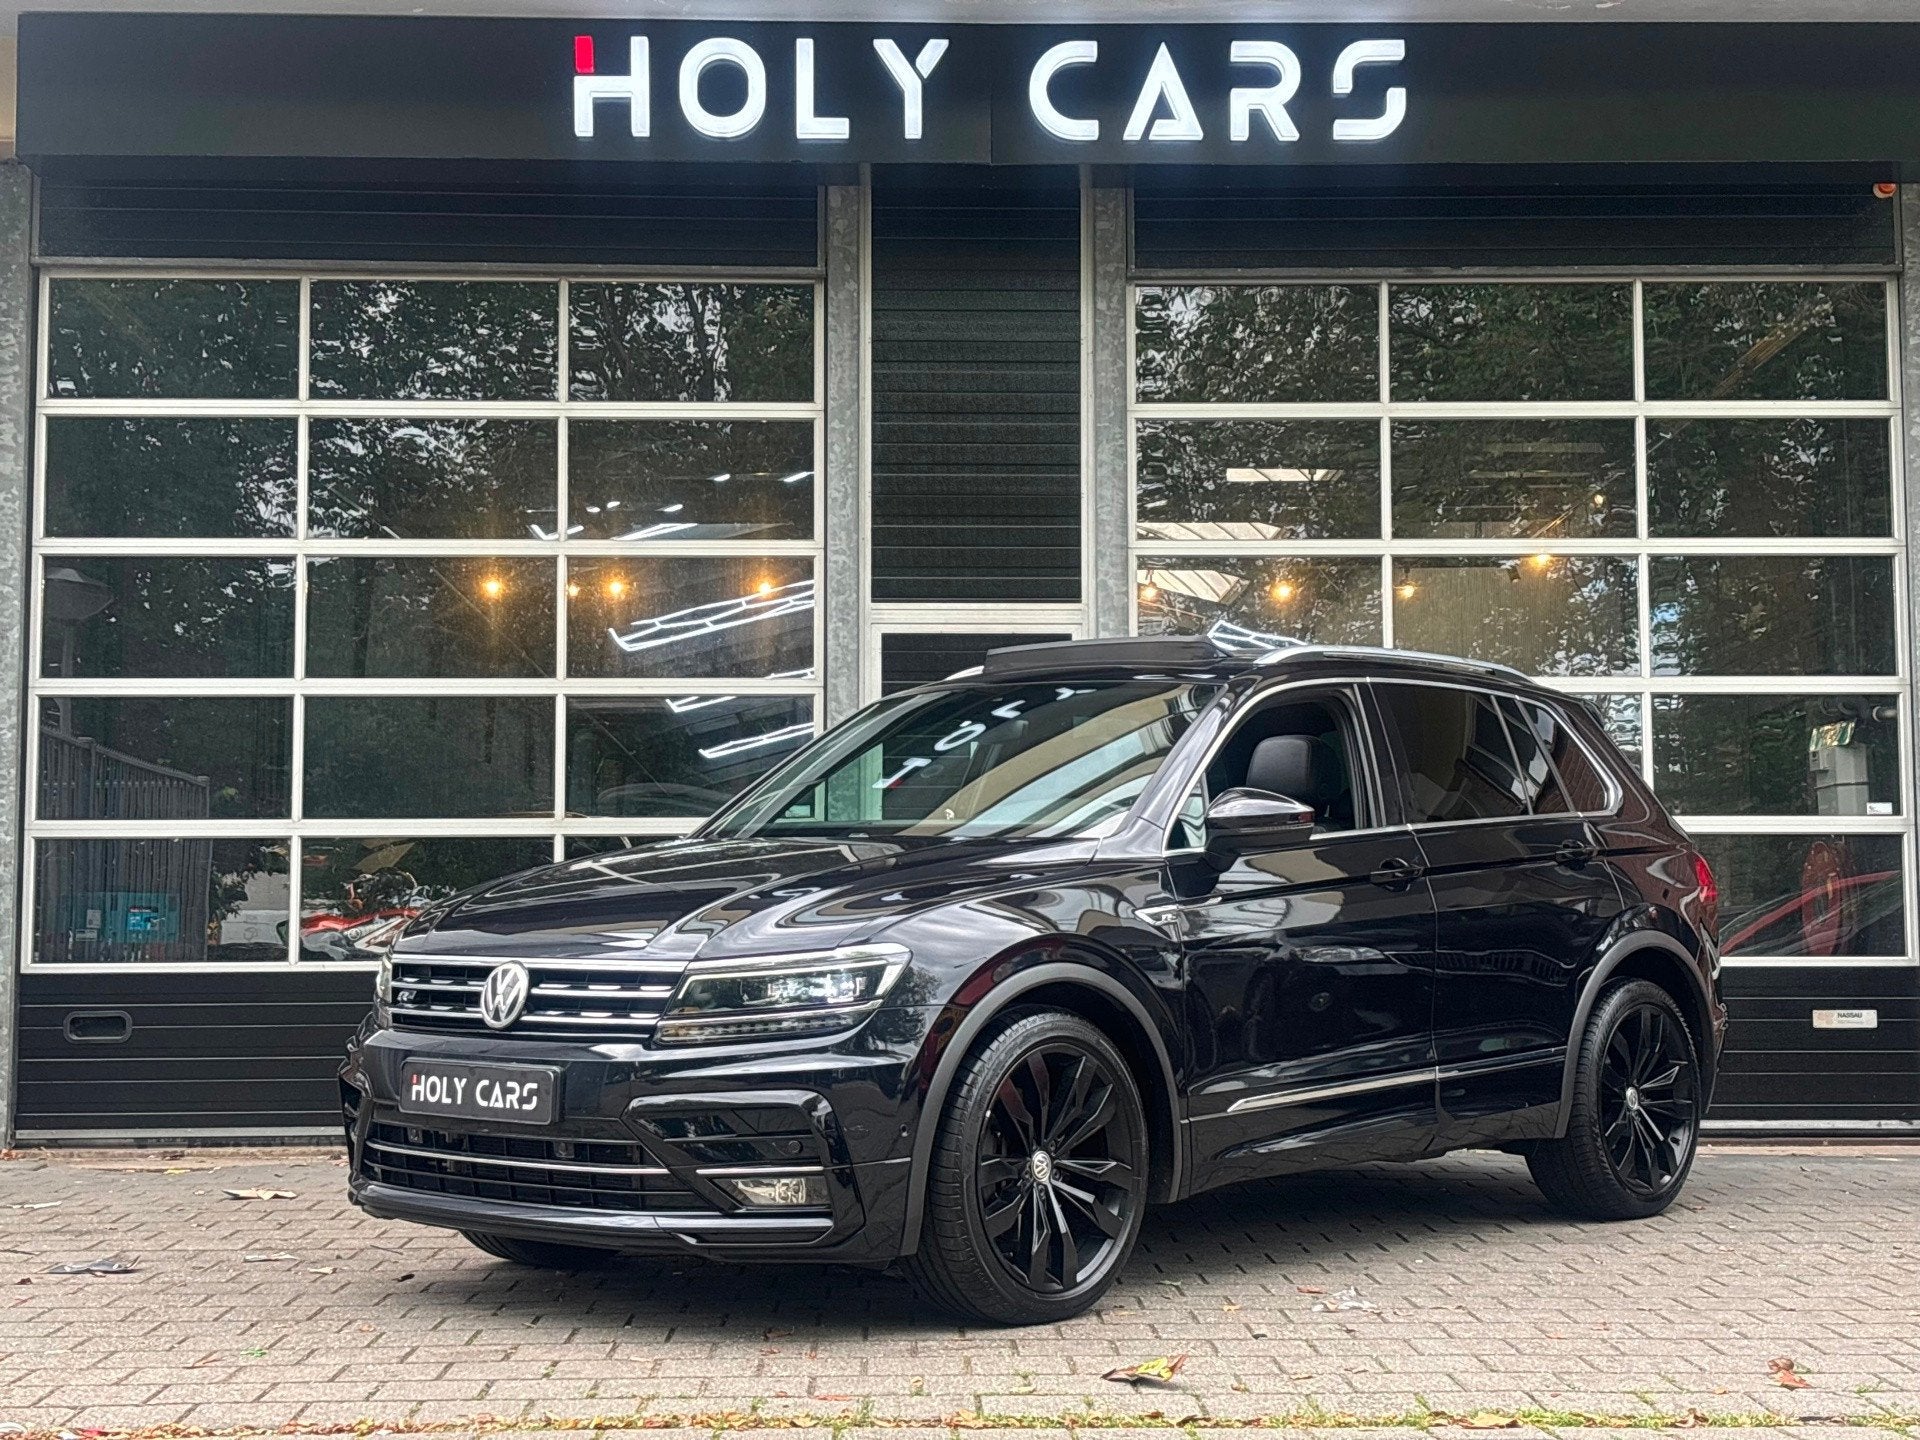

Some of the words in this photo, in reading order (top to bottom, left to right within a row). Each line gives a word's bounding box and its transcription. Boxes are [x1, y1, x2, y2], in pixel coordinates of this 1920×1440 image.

[574, 35, 949, 139] HOLY
[1029, 39, 1407, 141] CARS
[411, 1074, 467, 1105] HOLY
[475, 1079, 538, 1110] CARS
